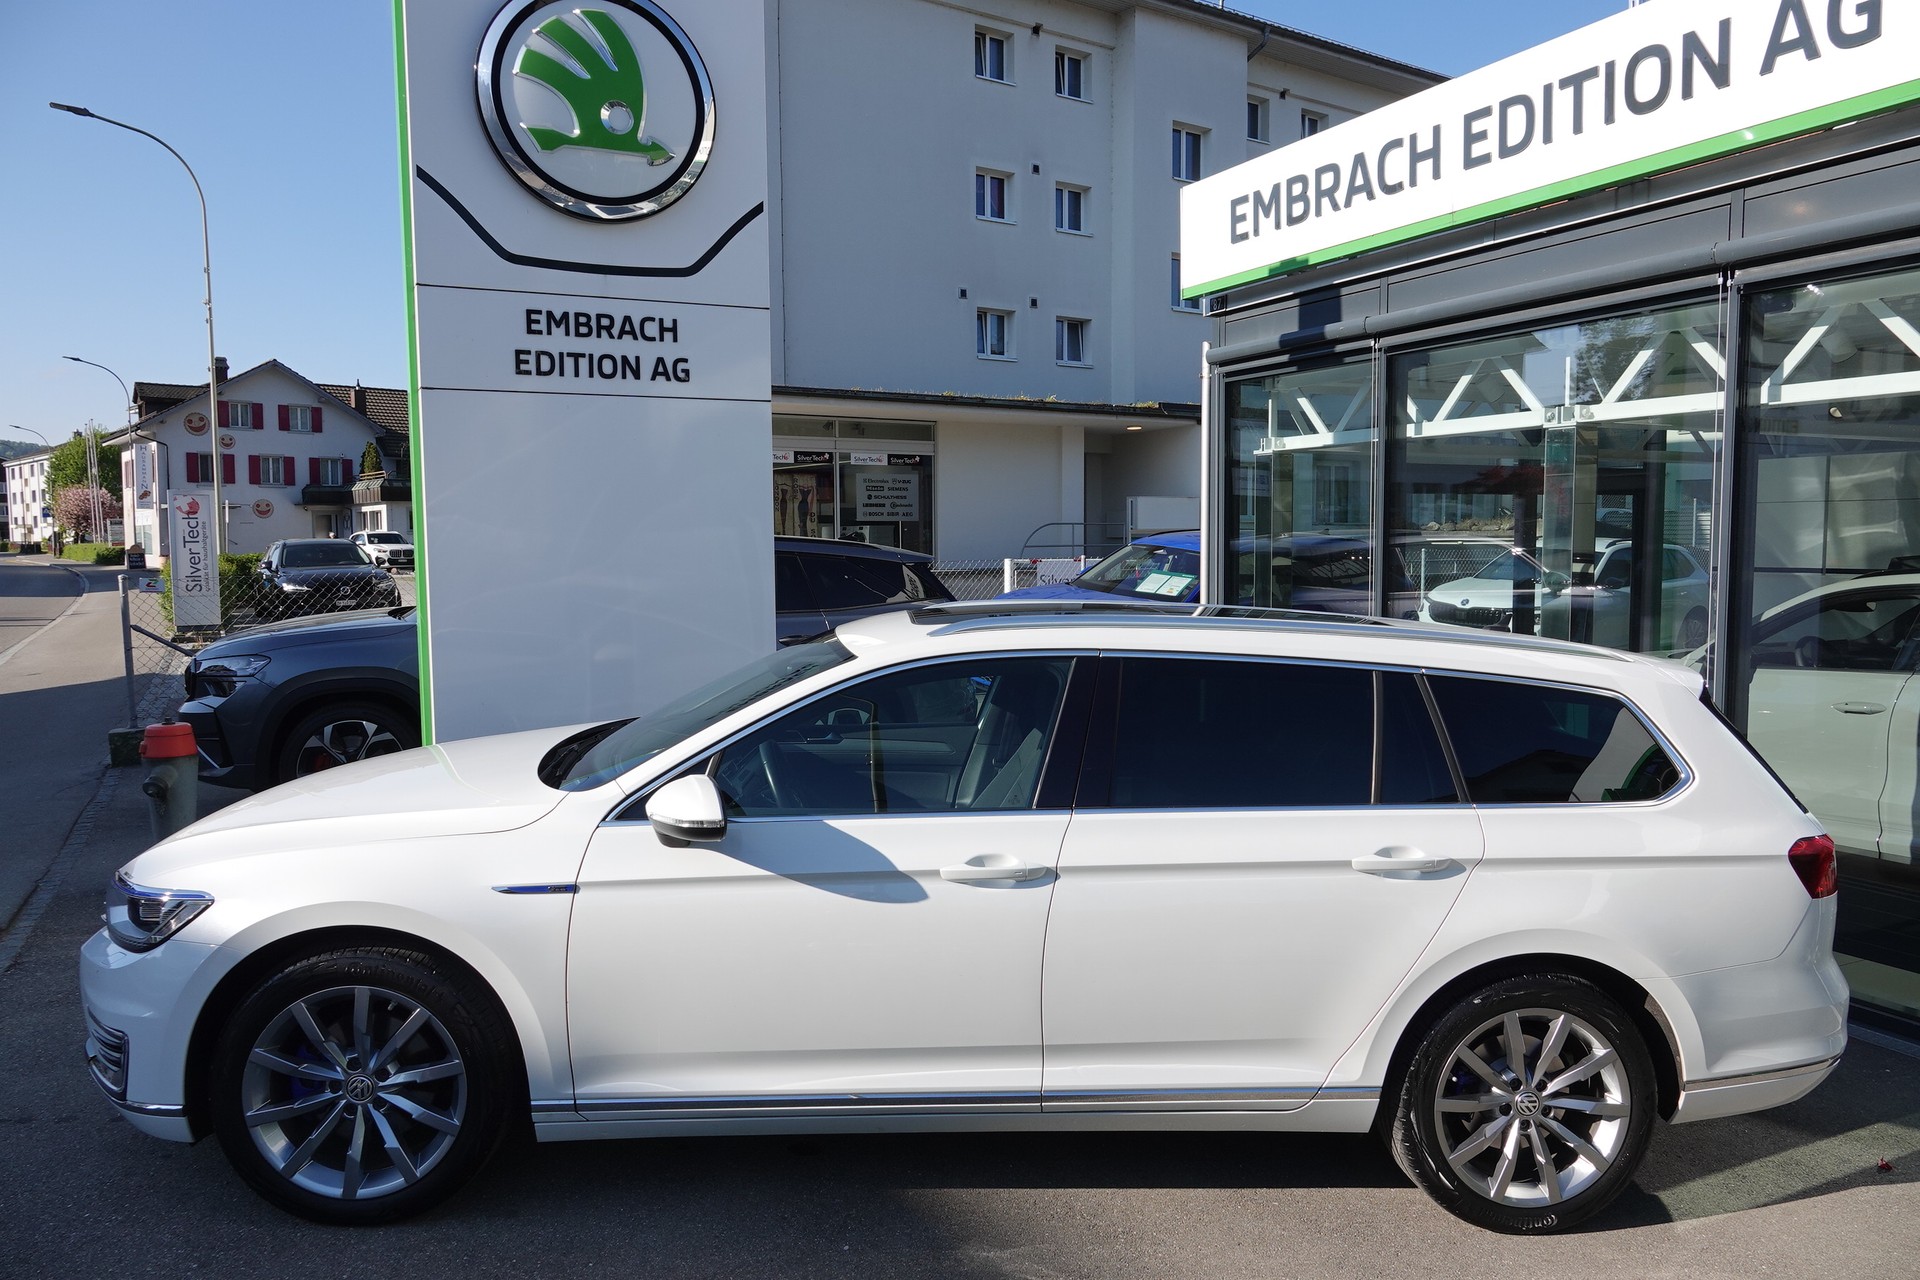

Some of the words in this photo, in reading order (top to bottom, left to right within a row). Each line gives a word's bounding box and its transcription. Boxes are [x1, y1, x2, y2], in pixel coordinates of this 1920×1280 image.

[1229, 124, 1442, 246] EMBRACH
[1462, 17, 1732, 172] EDITION
[1759, 0, 1883, 77] AG
[525, 308, 679, 343] EMBRACH
[514, 349, 641, 381] EDITION
[650, 356, 691, 383] AG
